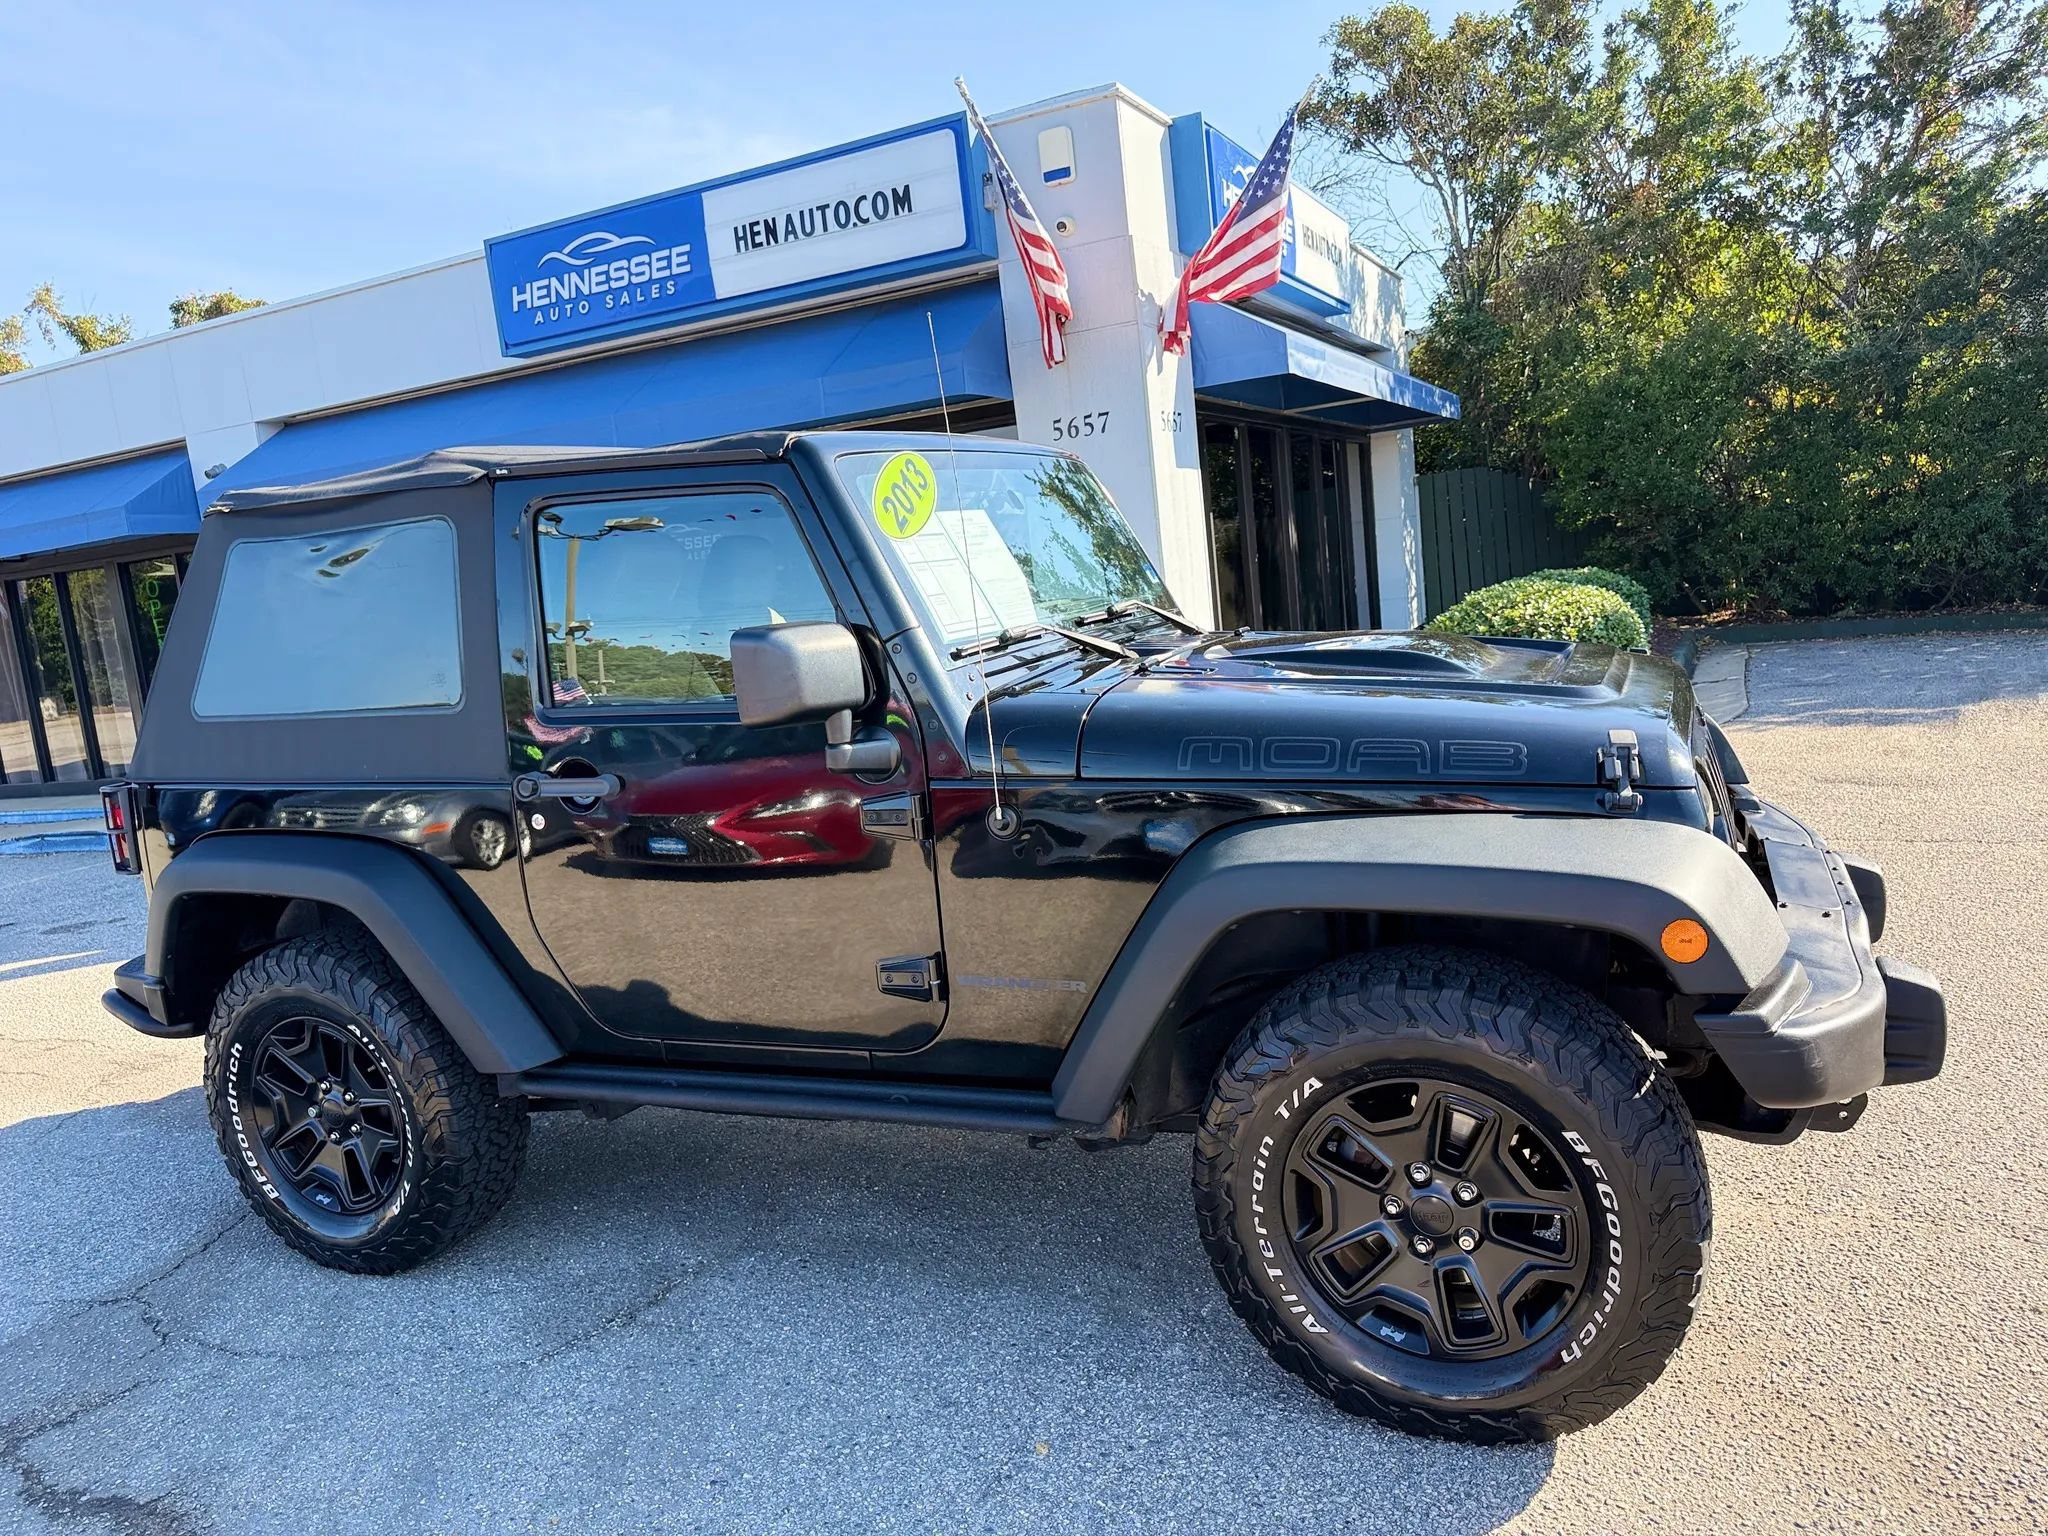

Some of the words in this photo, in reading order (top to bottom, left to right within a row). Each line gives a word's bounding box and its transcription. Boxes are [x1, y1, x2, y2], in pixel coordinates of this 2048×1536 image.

[733, 184, 913, 253] HENAUTO.COM
[512, 243, 692, 312] HENNESSEE
[534, 301, 590, 325] AUTO
[605, 280, 676, 309] SALES
[1053, 411, 1110, 441] 5657
[882, 458, 929, 534] 2013
[1176, 736, 1528, 776] MOAB
[227, 1042, 281, 1200] BFGoodrich
[347, 1024, 415, 1168] All-Terrain
[1273, 1076, 1325, 1121] T/A
[1252, 1135, 1330, 1337] All-Terrain
[1560, 1130, 1625, 1365] BFGoodrich
